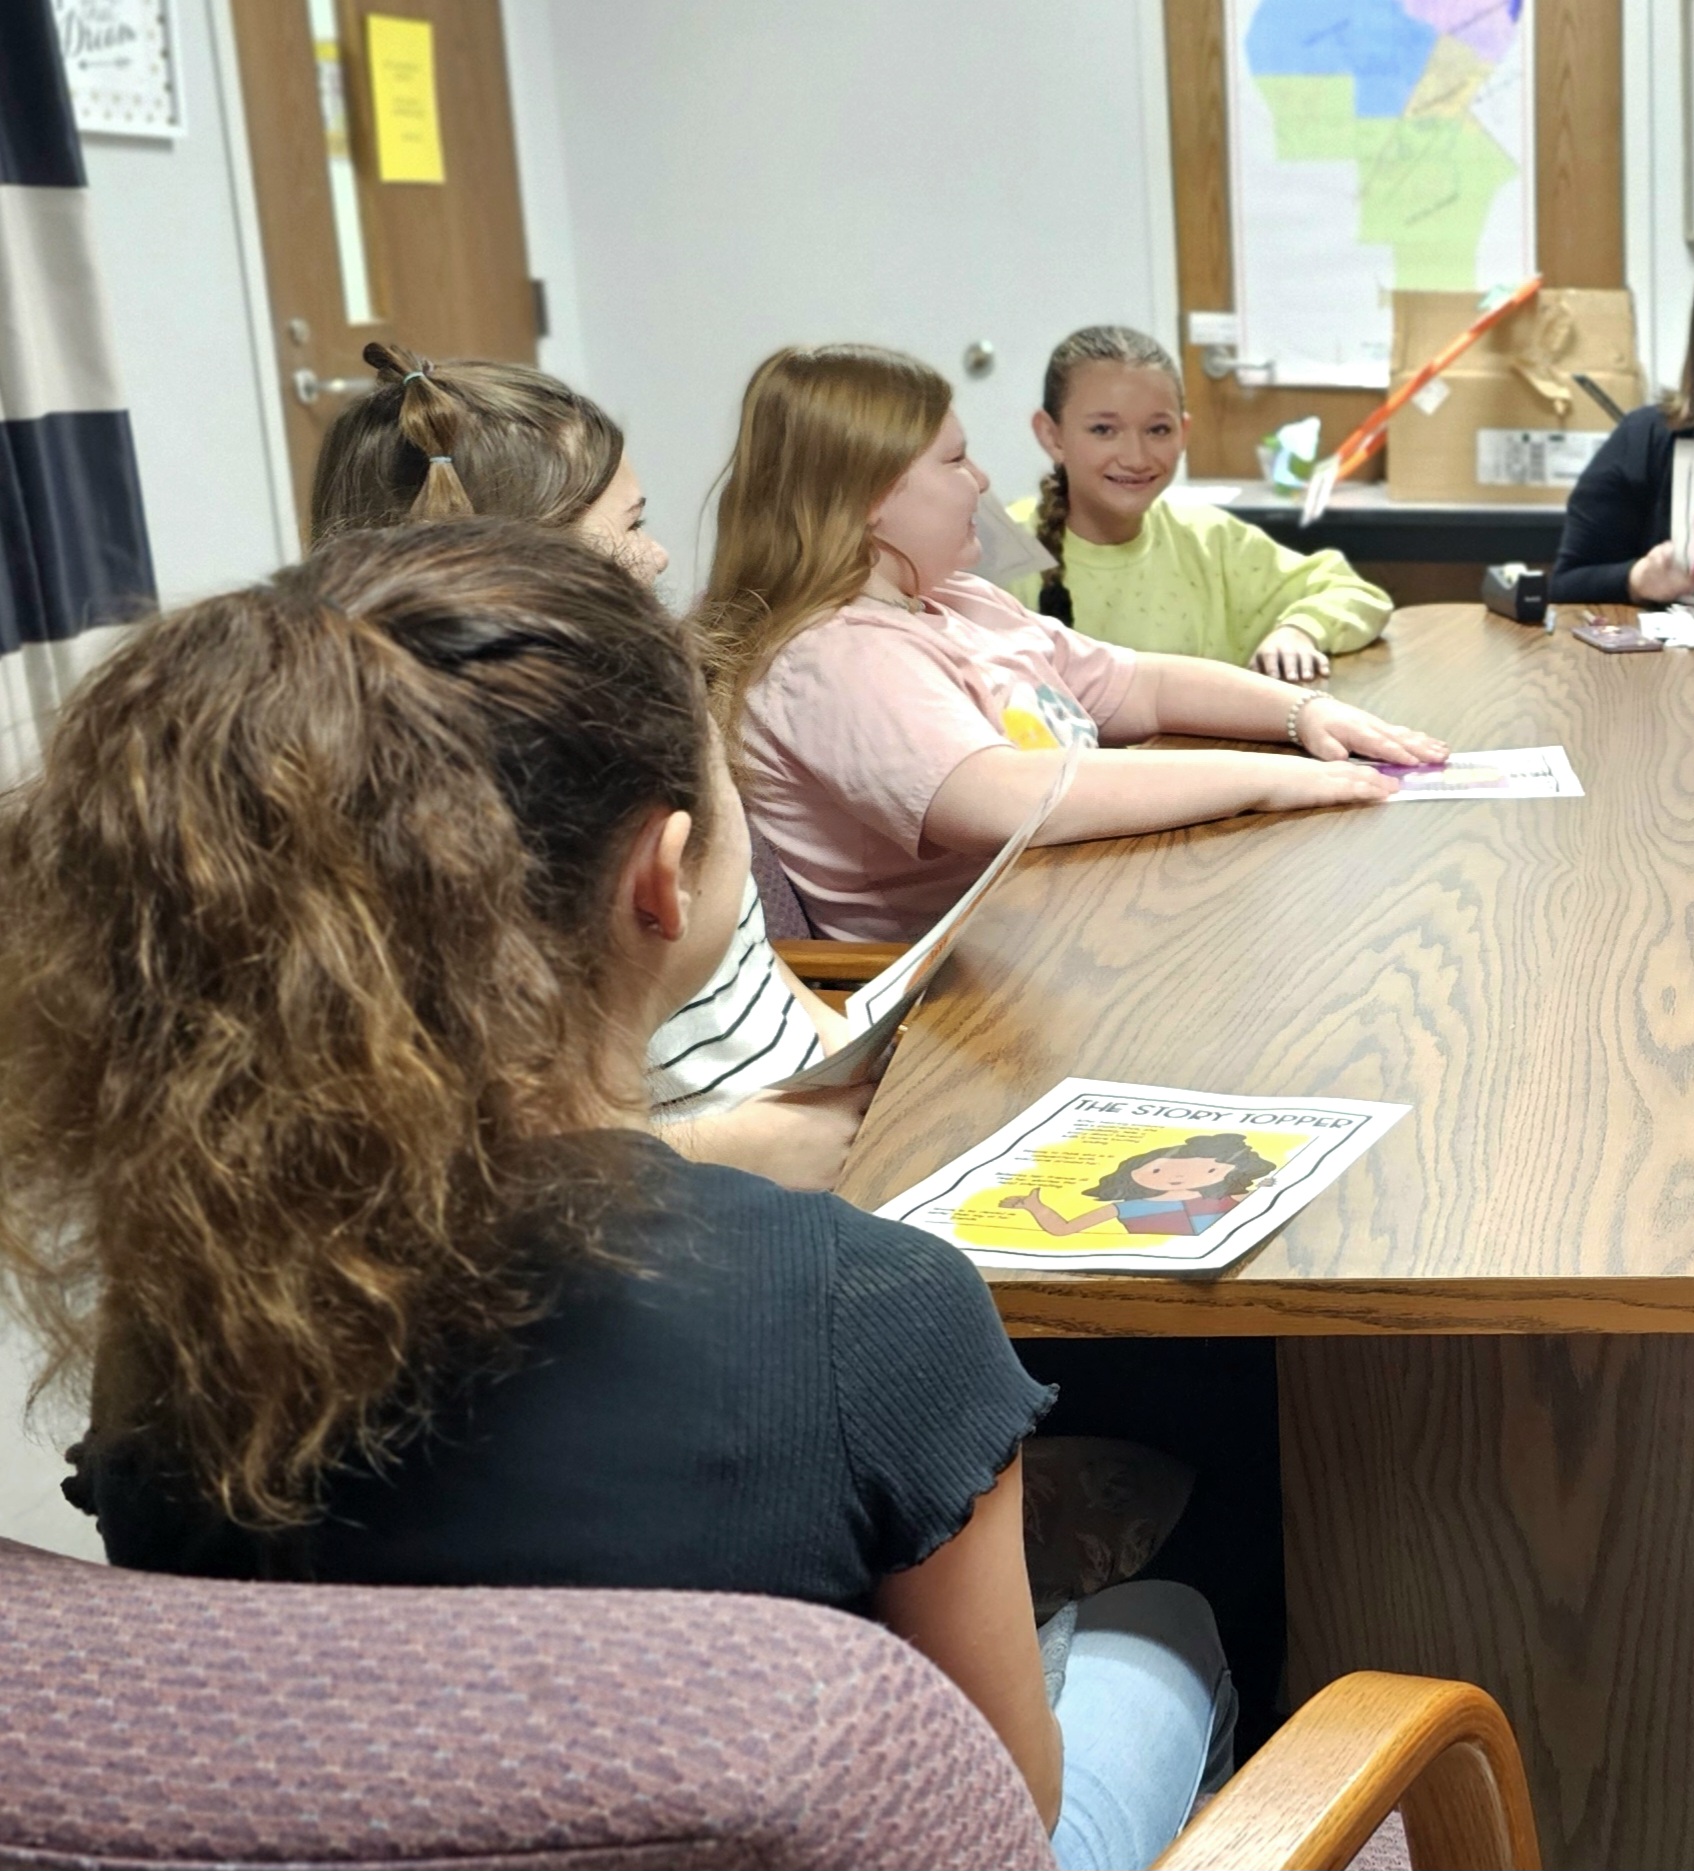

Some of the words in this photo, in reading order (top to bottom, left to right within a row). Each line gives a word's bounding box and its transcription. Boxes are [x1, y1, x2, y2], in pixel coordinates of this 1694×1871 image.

[1073, 1099, 1128, 1113] THE
[1132, 1104, 1232, 1122] STORY
[1240, 1113, 1354, 1129] TOPPER
